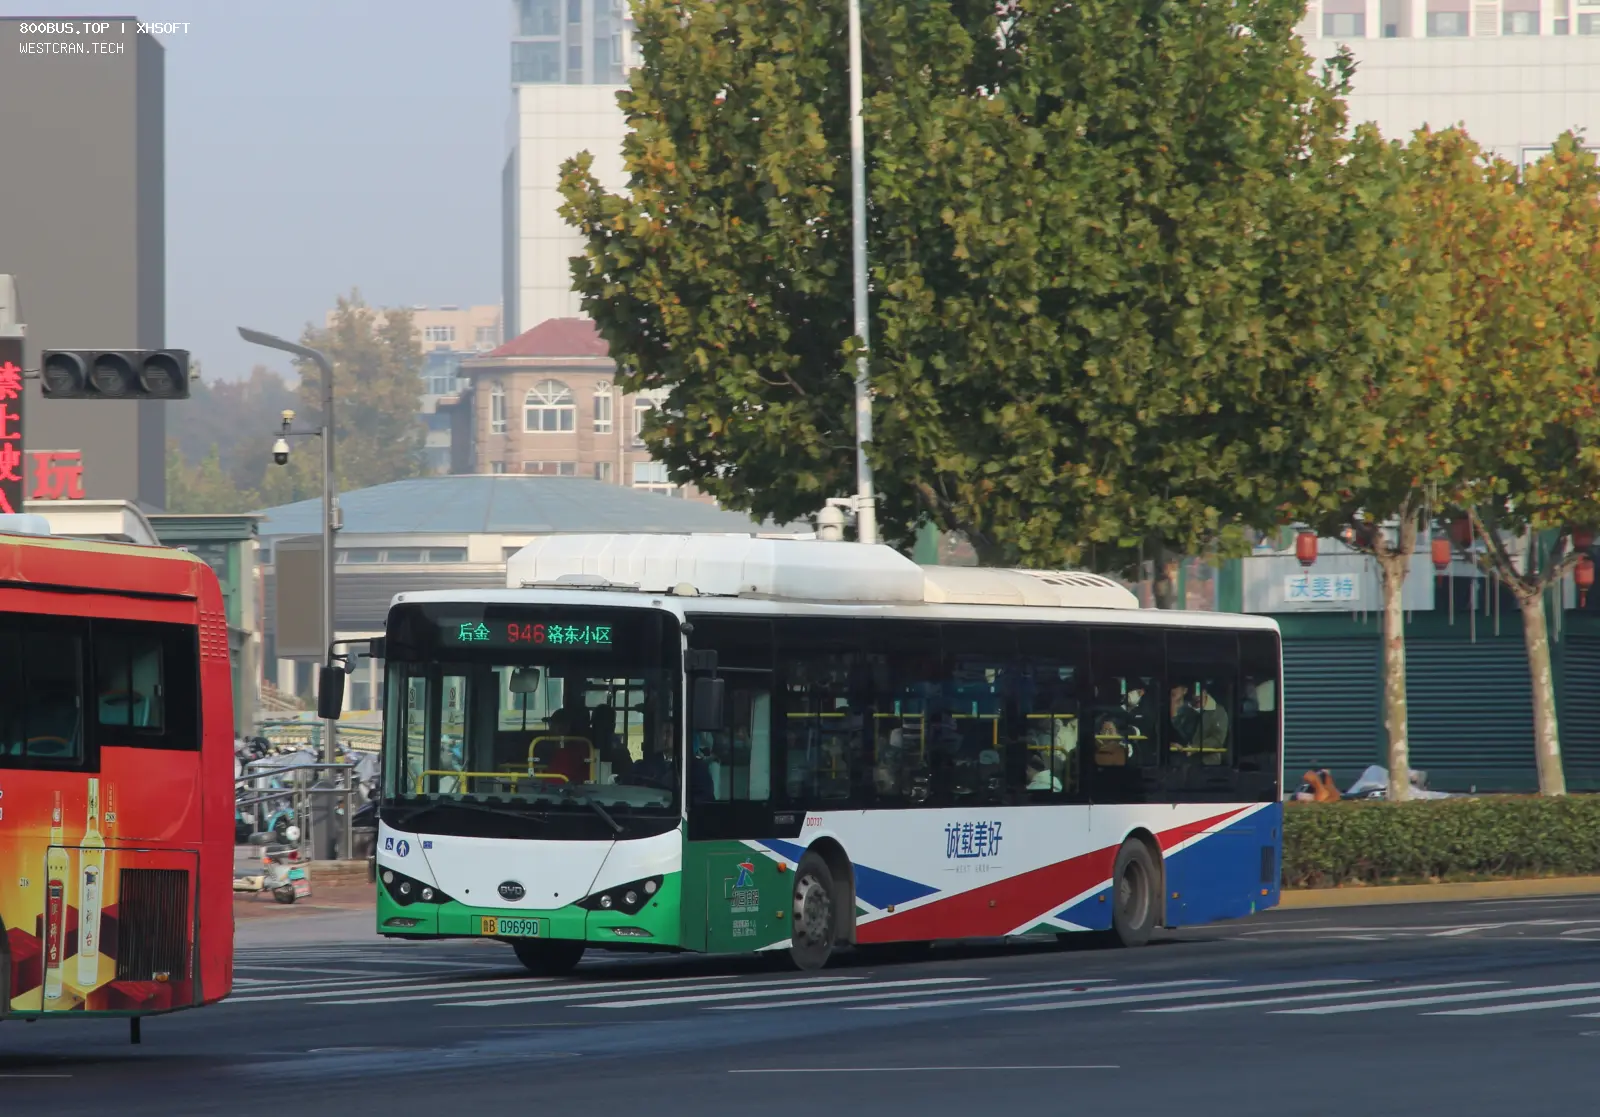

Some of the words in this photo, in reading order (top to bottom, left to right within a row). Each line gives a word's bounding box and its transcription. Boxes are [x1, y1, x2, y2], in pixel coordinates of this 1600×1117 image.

[458, 622, 491, 642] 后金
[507, 623, 545, 643] 946
[548, 624, 613, 645] 洛东小区
[944, 820, 1003, 859] 诚载美好
[500, 885, 523, 895] BYD
